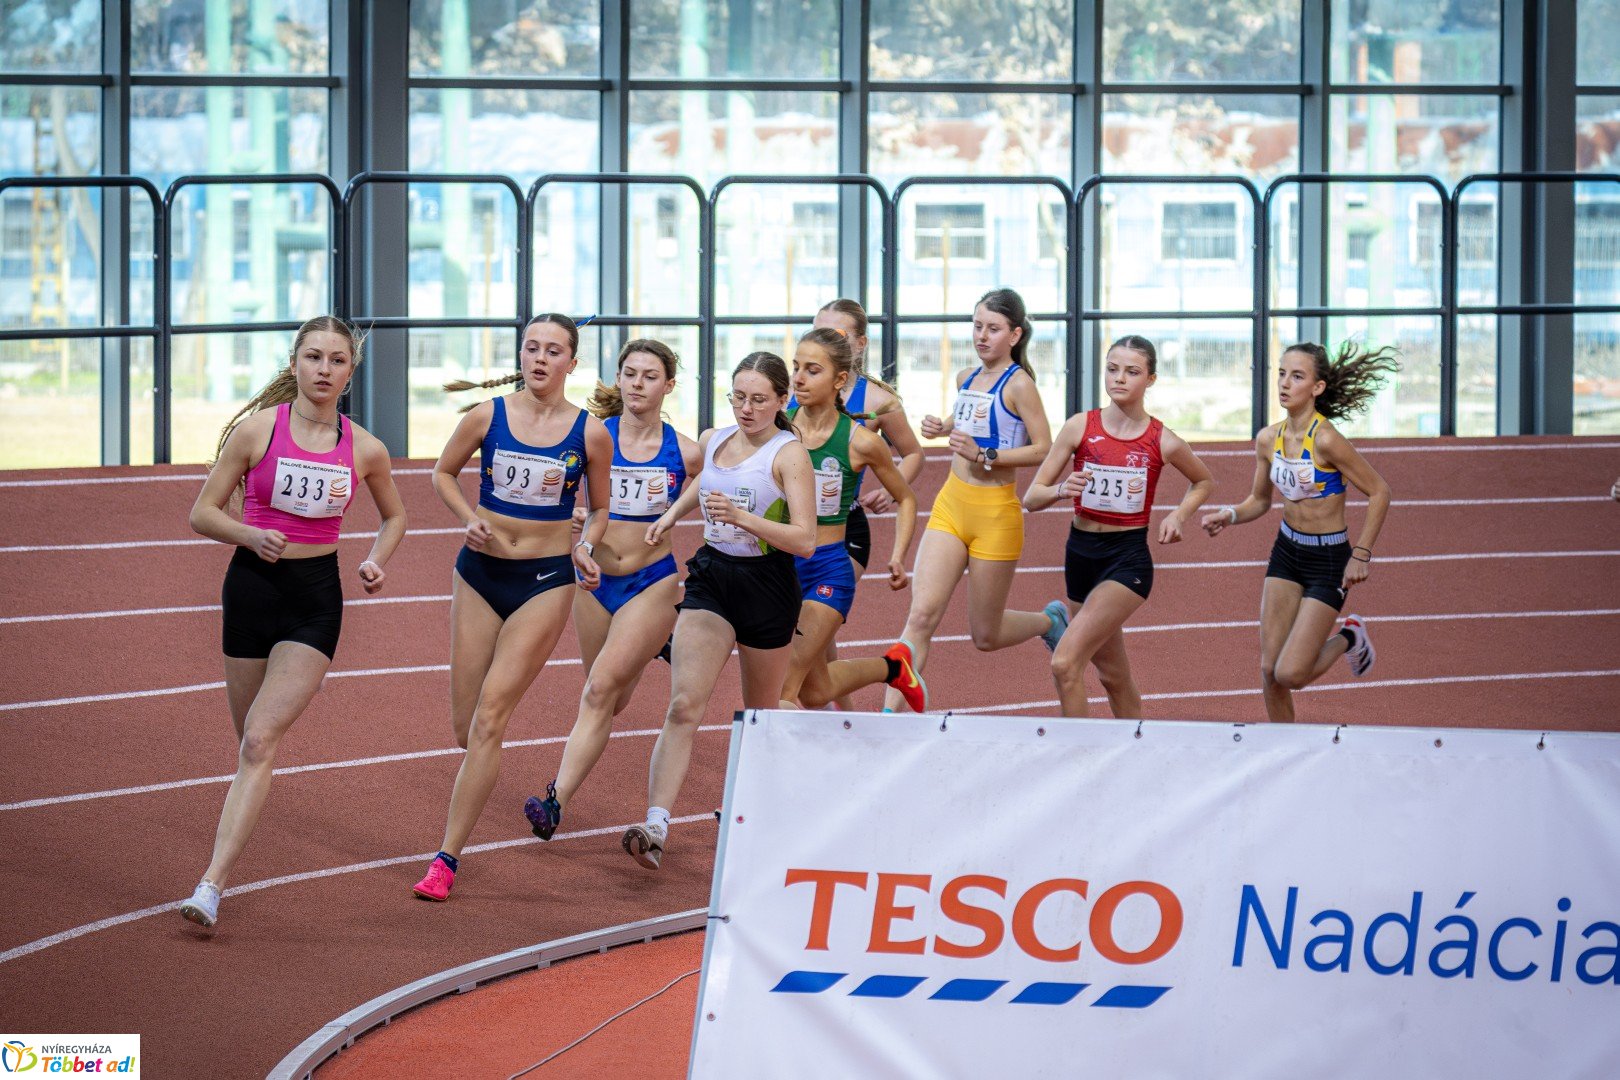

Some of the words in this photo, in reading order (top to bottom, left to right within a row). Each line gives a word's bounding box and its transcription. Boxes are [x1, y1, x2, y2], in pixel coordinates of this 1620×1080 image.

[281, 474, 324, 501] 233
[506, 465, 530, 489] 93
[609, 478, 643, 499] 157
[1088, 476, 1123, 498] 225
[784, 868, 1184, 965] TESCO
[1232, 884, 1620, 986] Nadácia
